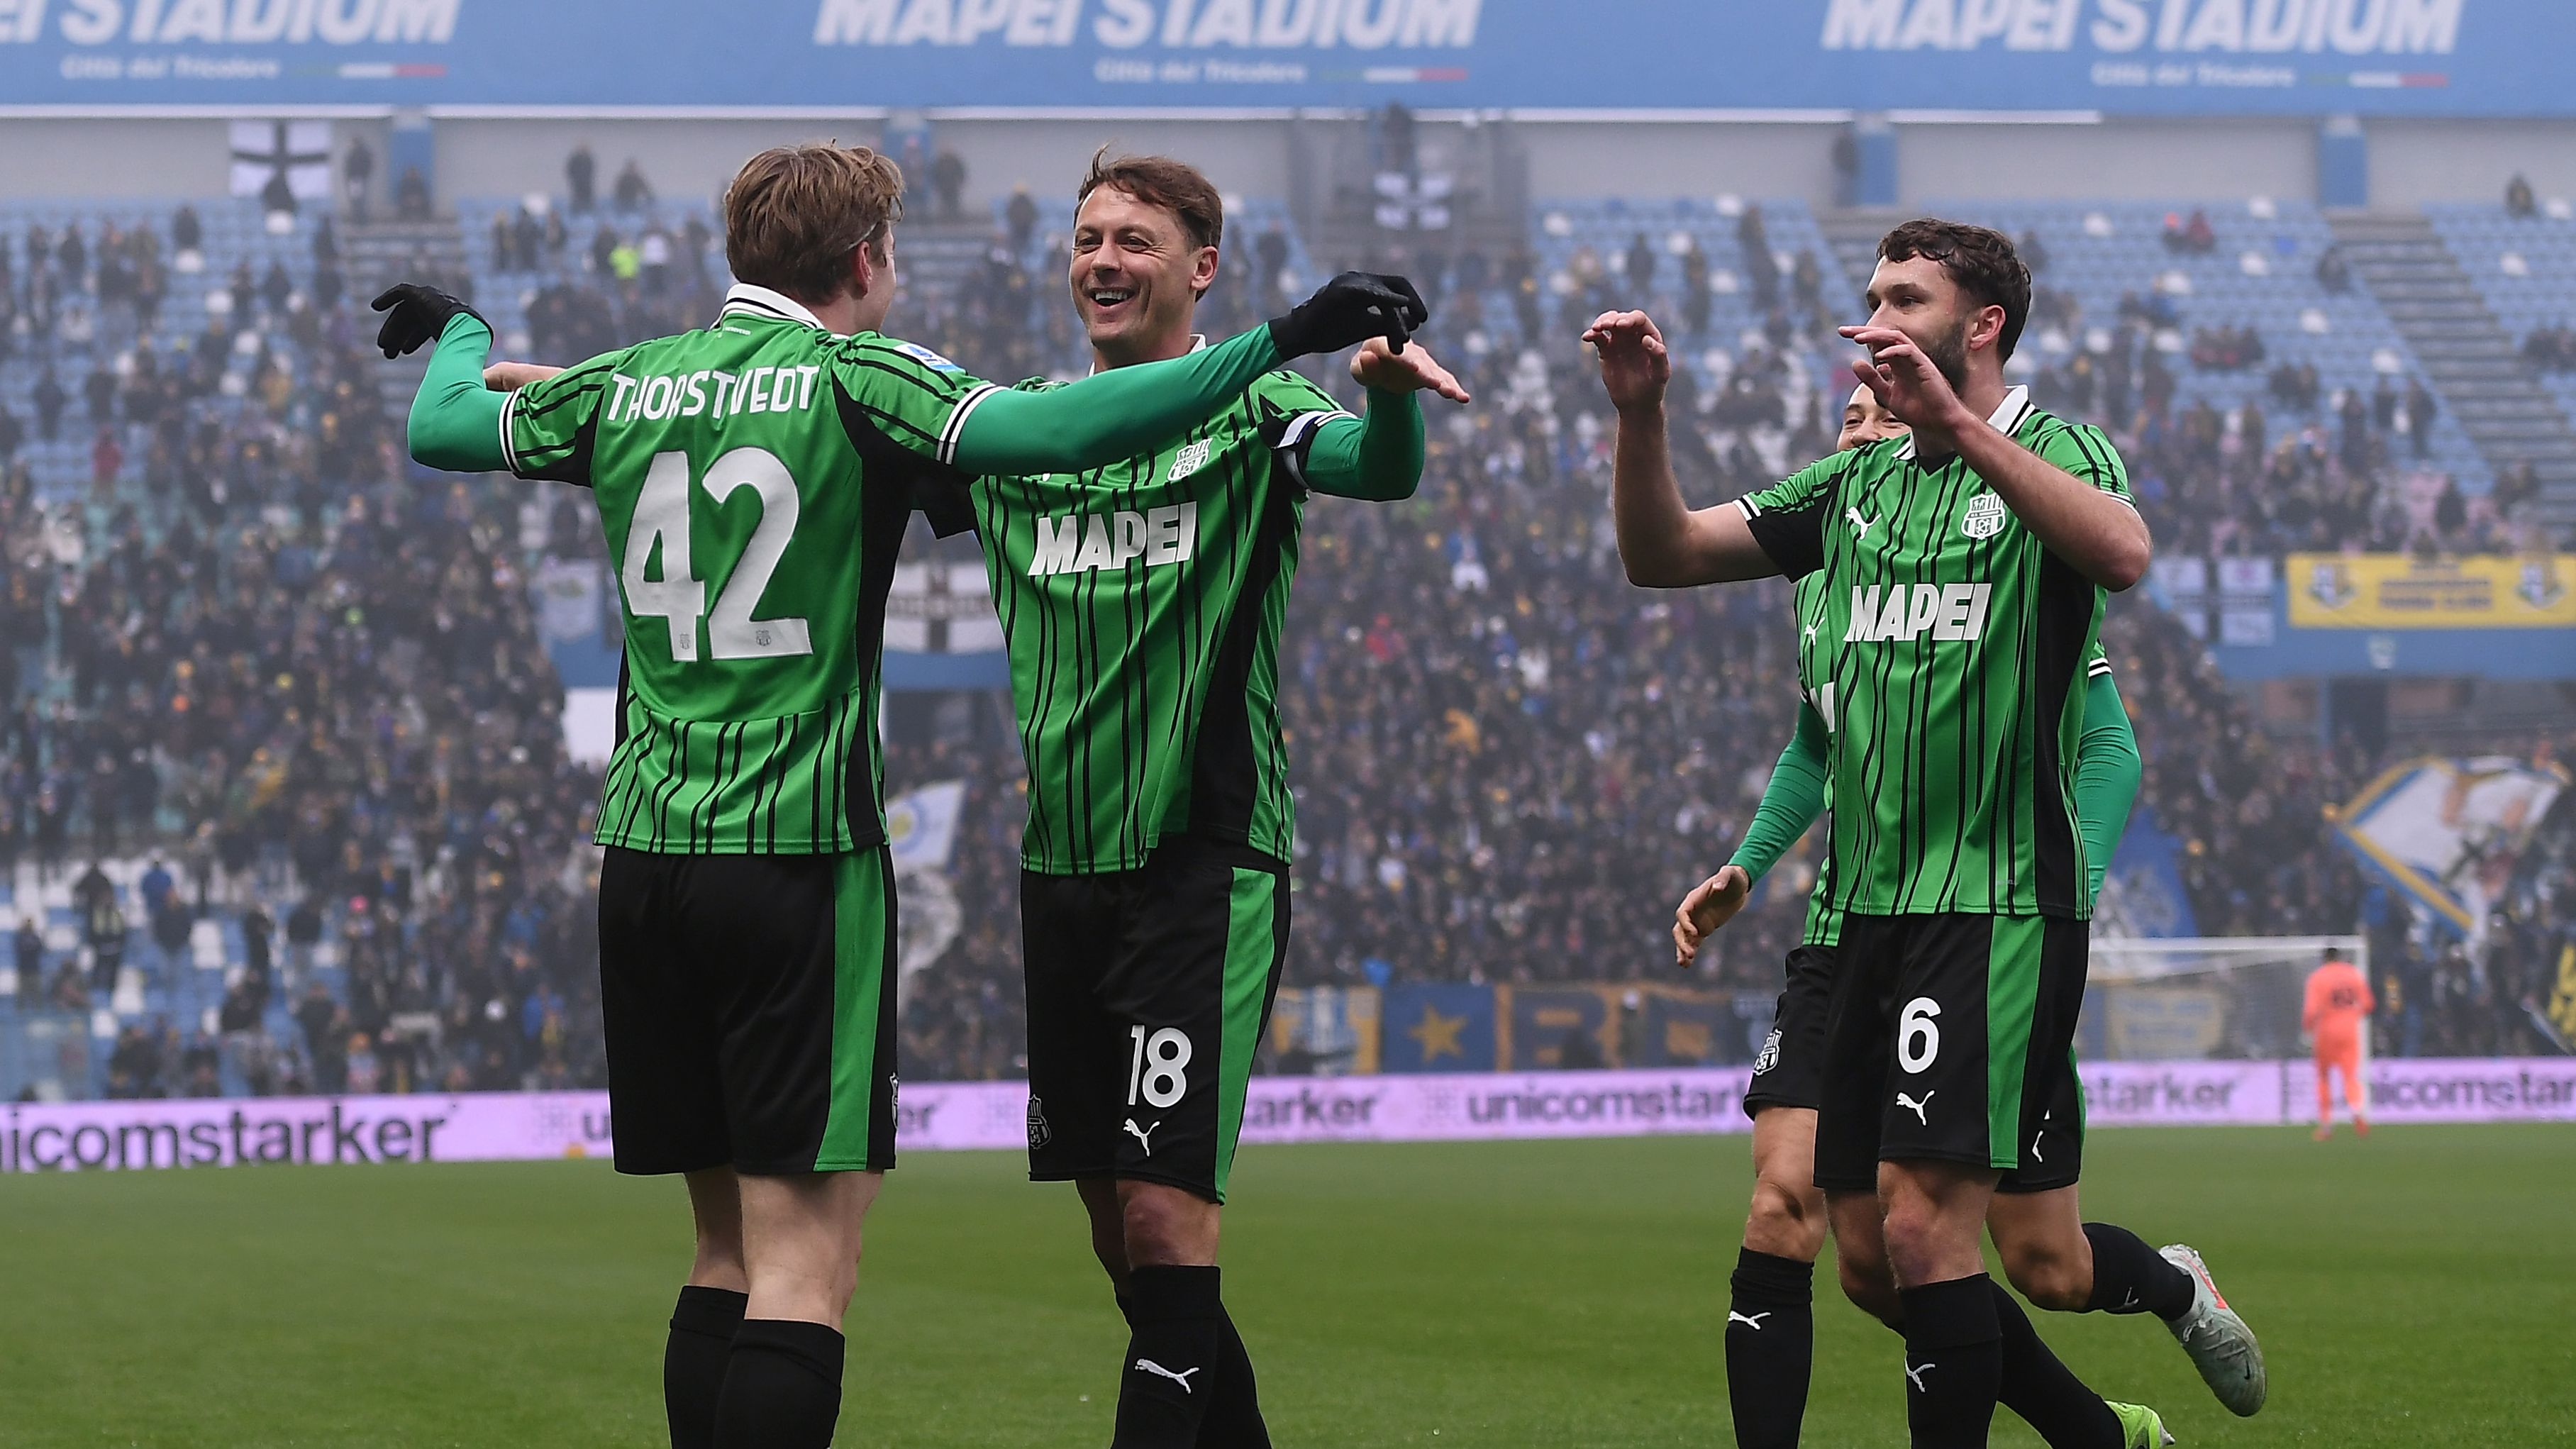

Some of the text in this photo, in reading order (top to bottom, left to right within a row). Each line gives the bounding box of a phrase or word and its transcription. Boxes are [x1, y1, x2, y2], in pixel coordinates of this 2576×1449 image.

[59, 0, 460, 45] STADIUM
[814, 0, 1483, 48] MAPEI STADIUM
[1821, 0, 2463, 53] MAPEI STADIUM
[607, 365, 820, 423] THORSTVEDT
[621, 446, 814, 662] 42
[1028, 501, 1197, 576] MAPEI
[1843, 583, 1992, 641] MAPEI
[1898, 996, 1942, 1074] 6
[1128, 1024, 1192, 1108] 18
[0, 1104, 445, 1168] icomstarker
